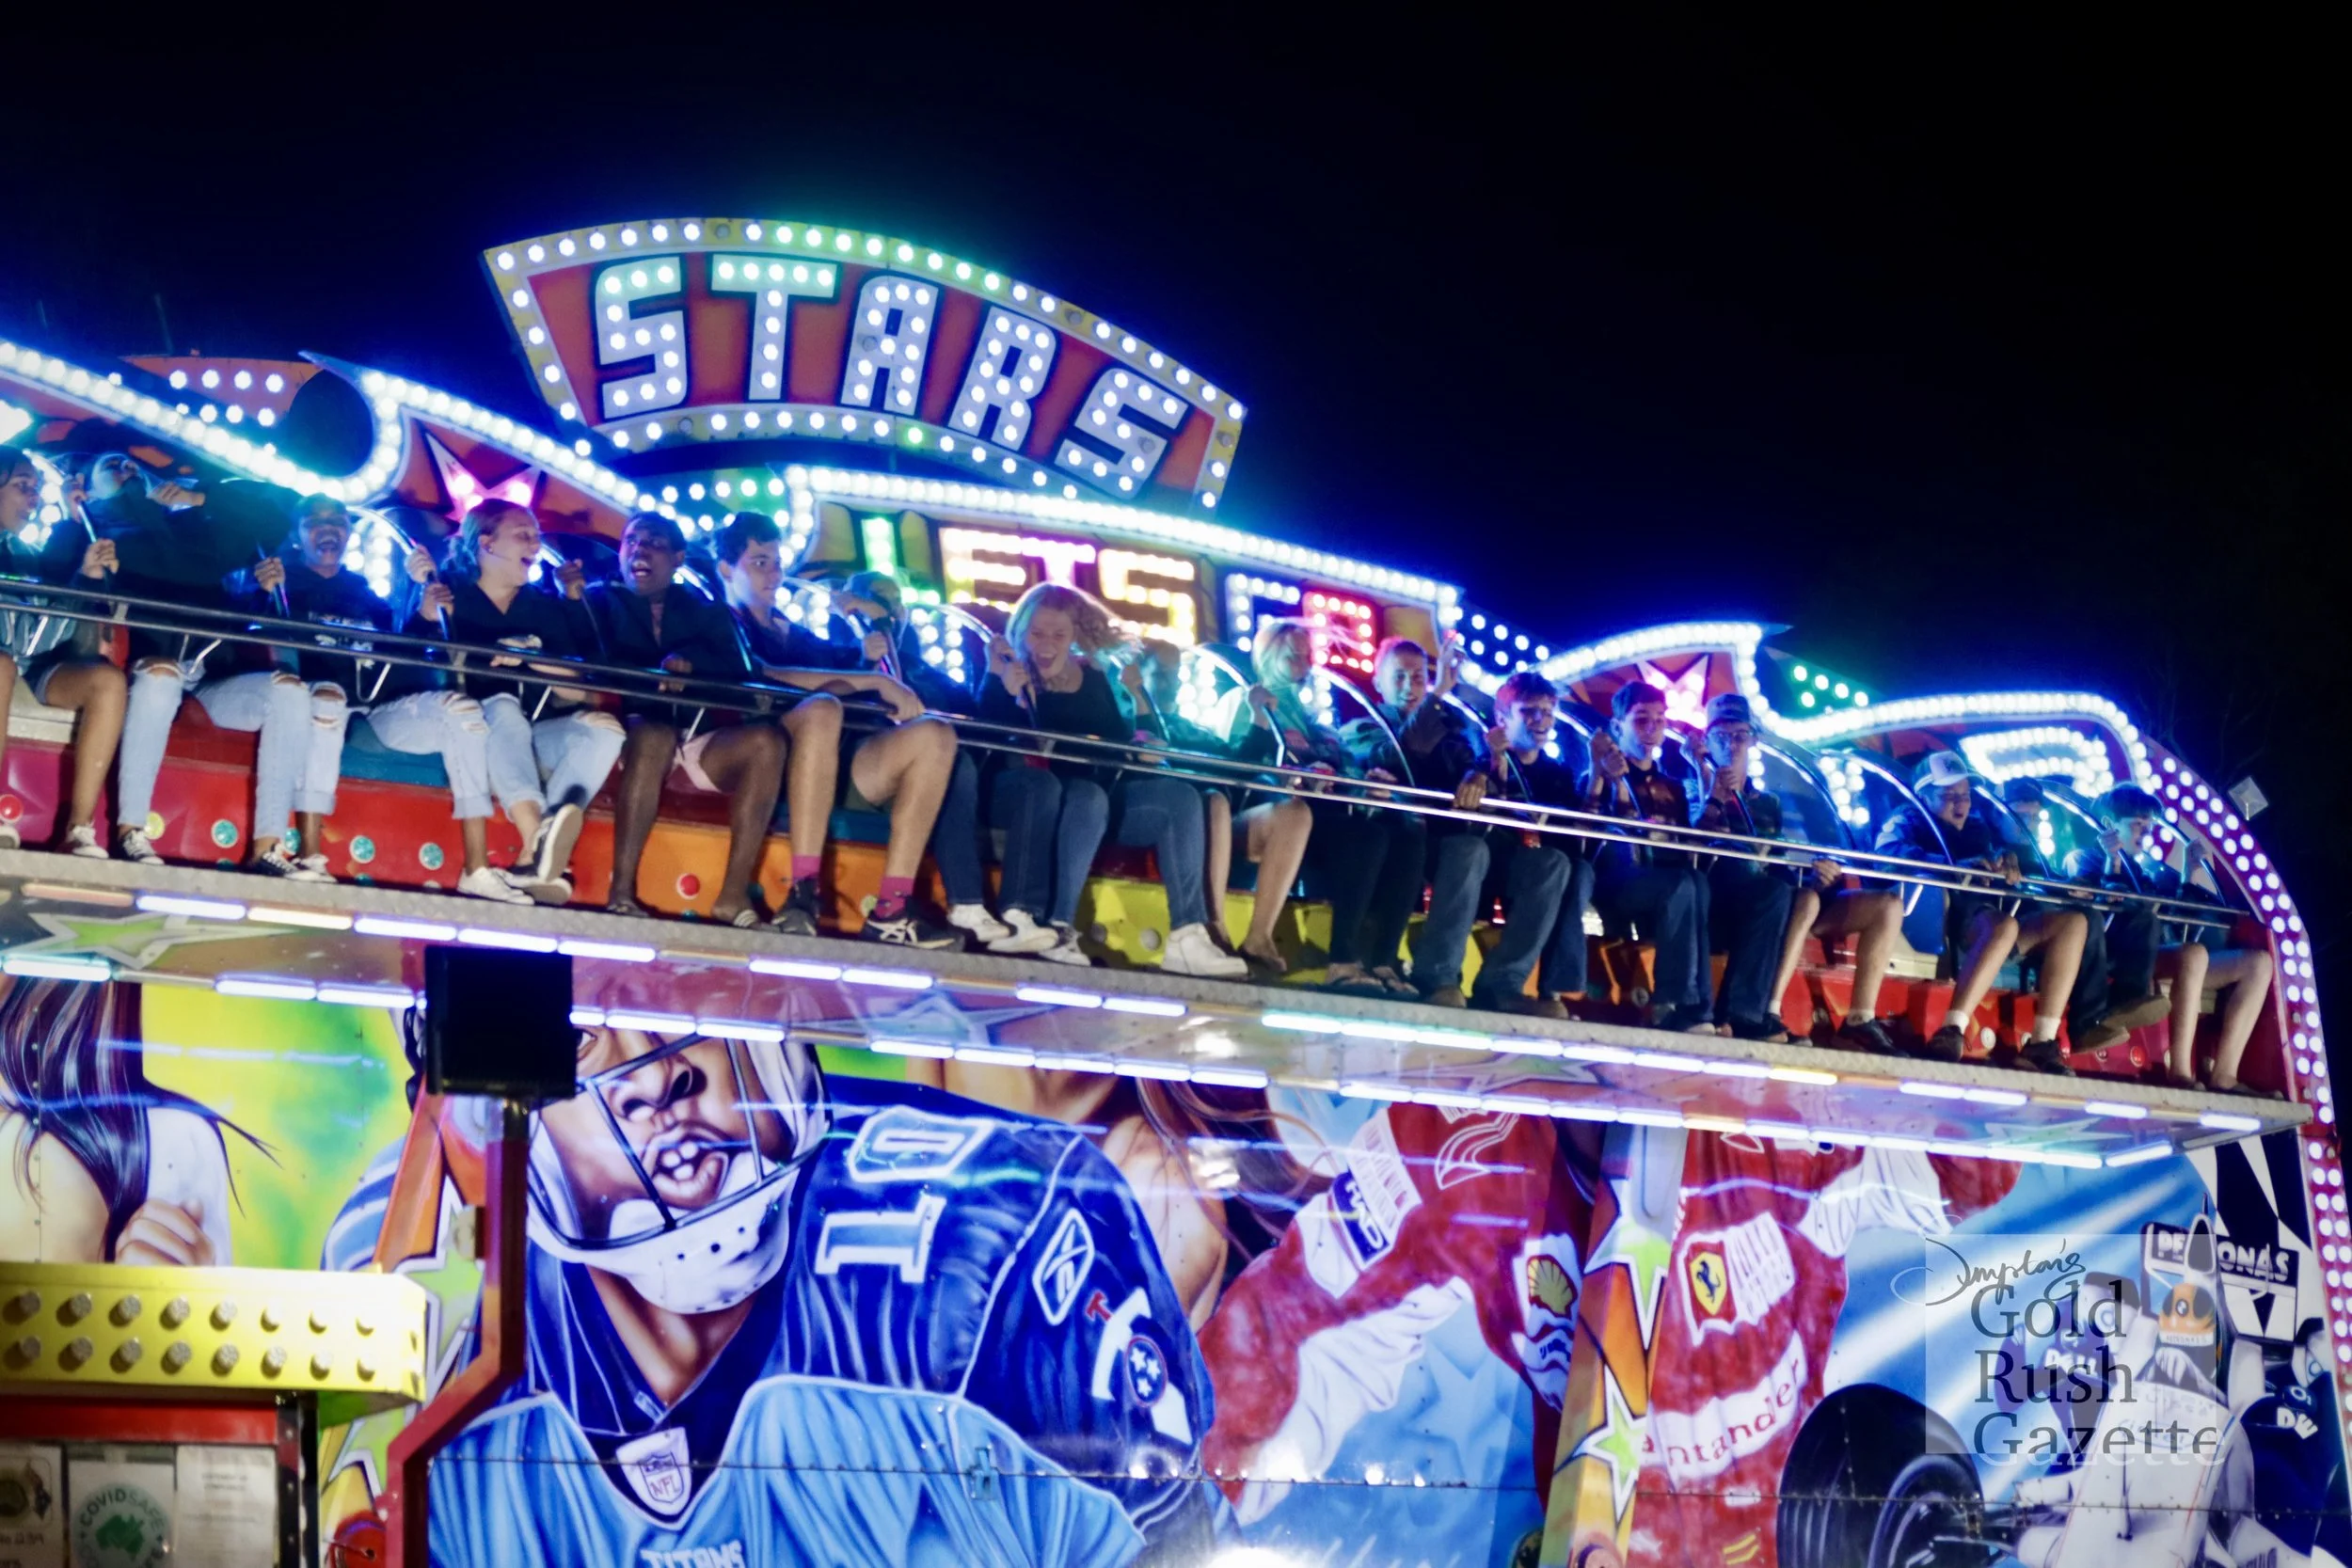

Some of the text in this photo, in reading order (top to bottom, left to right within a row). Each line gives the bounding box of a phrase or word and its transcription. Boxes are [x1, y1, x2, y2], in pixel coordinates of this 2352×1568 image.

[595, 253, 1190, 500] STARS
[815, 1104, 993, 1283] 10
[2156, 1229, 2290, 1283] PEONAS
[1641, 1358, 1799, 1466] antander
[649, 1474, 681, 1497] NFL
